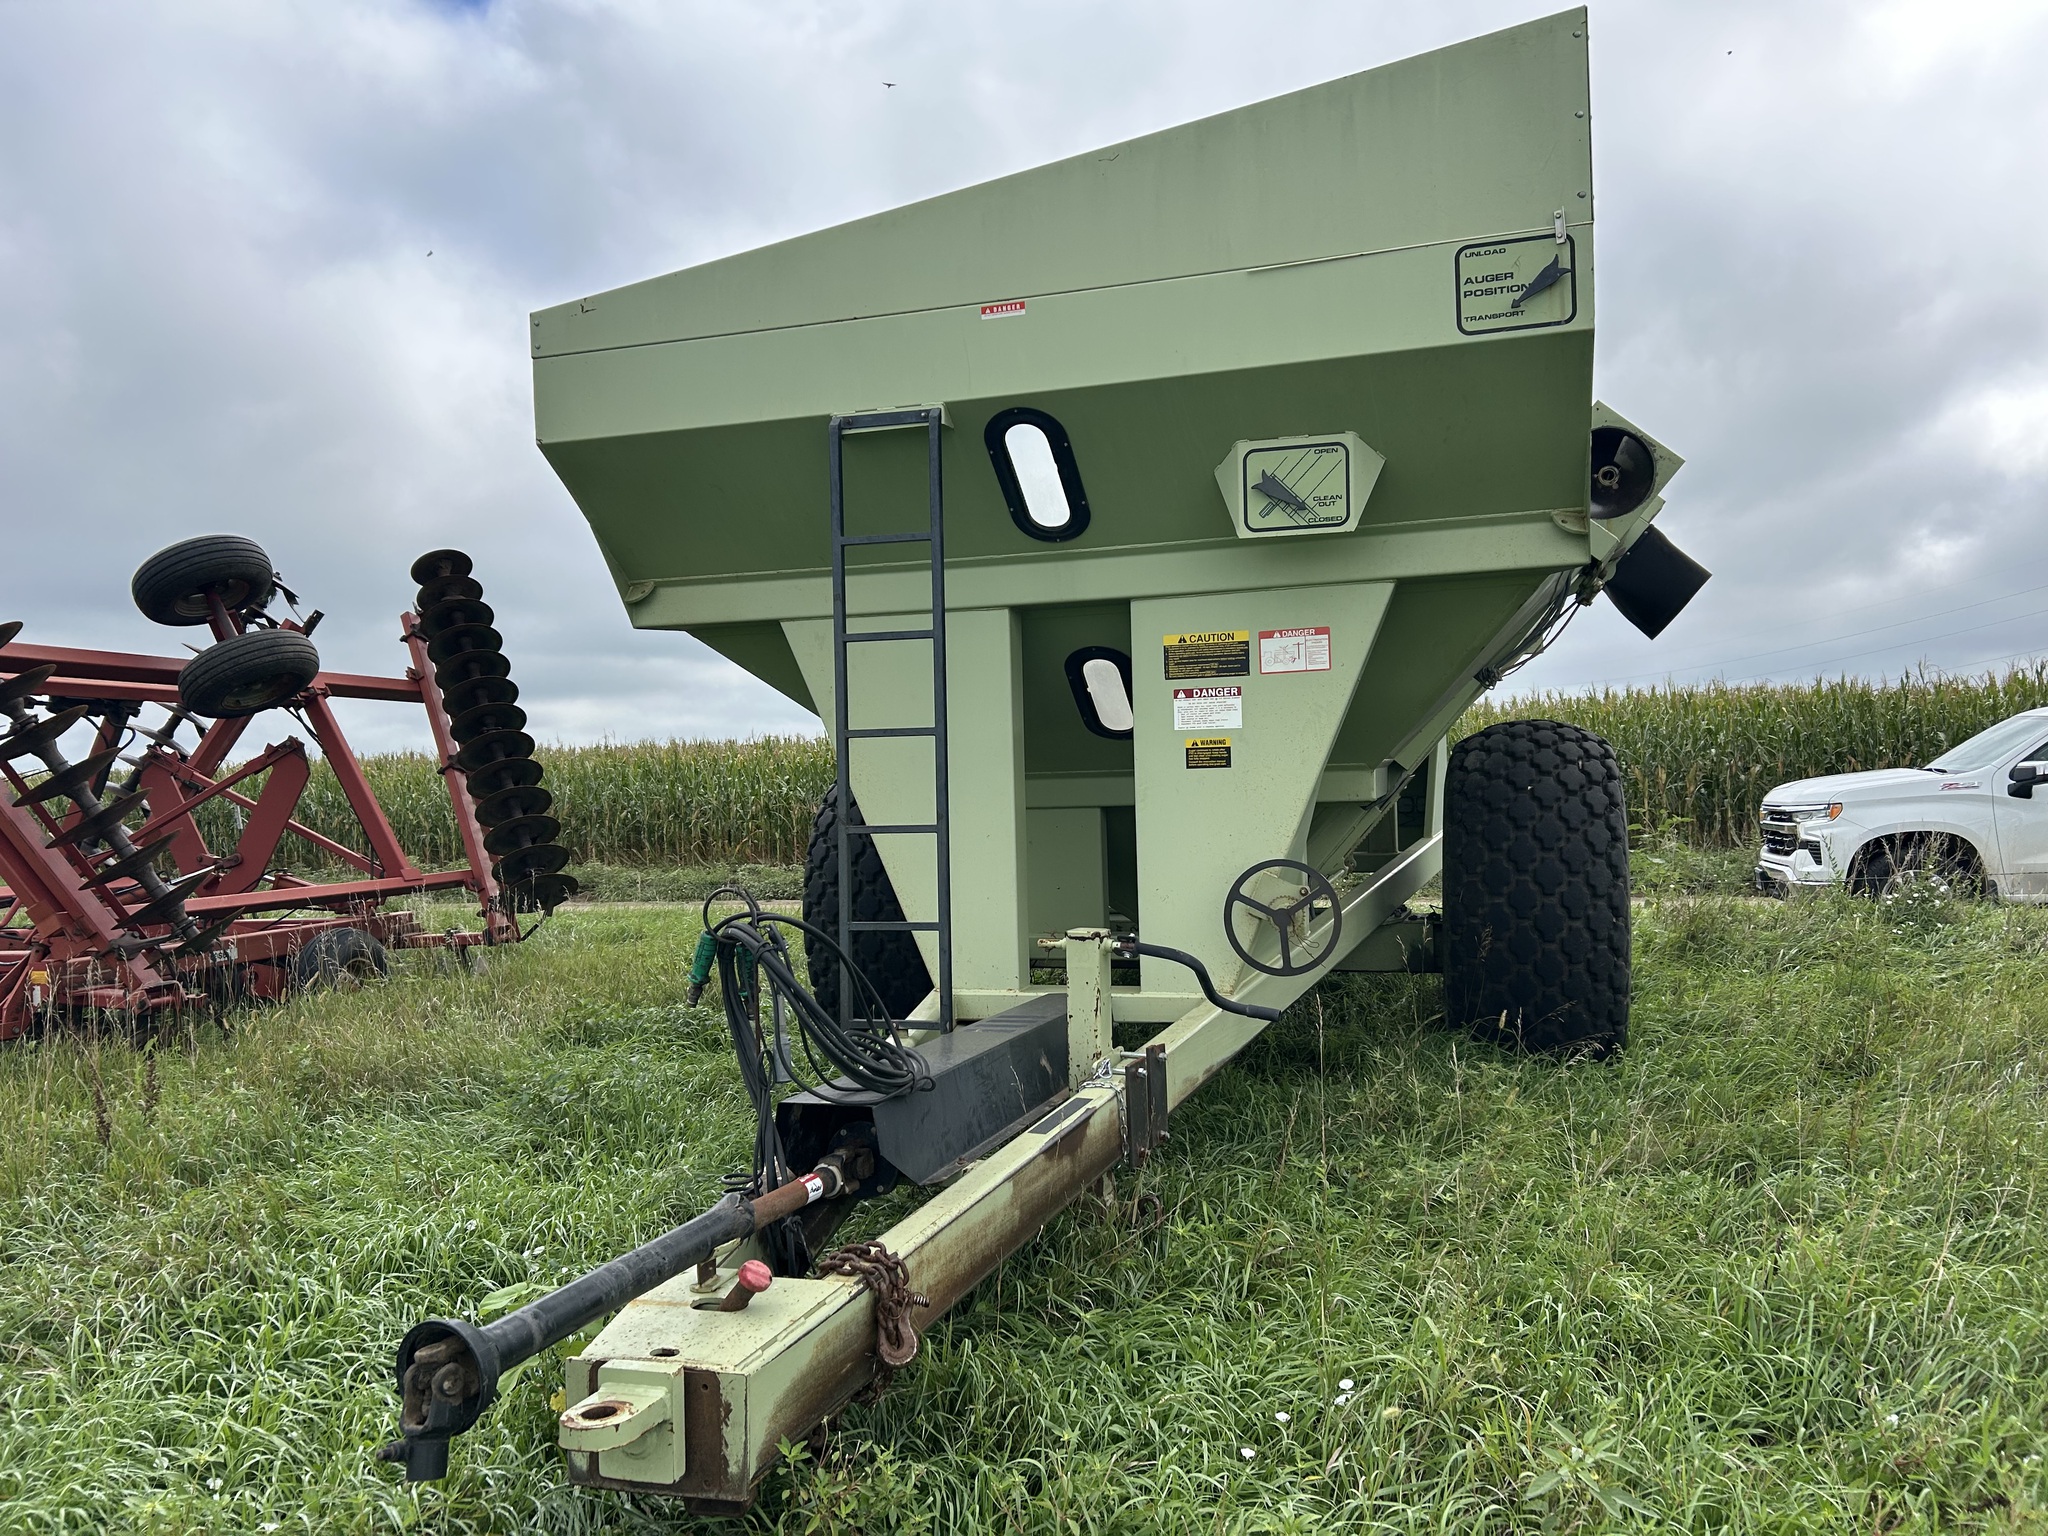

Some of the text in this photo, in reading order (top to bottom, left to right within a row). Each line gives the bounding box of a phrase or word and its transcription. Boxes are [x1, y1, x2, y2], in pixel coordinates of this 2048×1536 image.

[1465, 248, 1506, 258] UNLOAD
[1464, 272, 1514, 285] AUGER
[993, 303, 1021, 313] DANGER
[1464, 310, 1525, 322] TRANSPORT
[1314, 447, 1338, 455] OPEN
[1313, 494, 1342, 502] CLEAN
[1189, 632, 1235, 643] CAUTION
[1282, 628, 1315, 638] DANGER
[1193, 687, 1238, 698] DANGER
